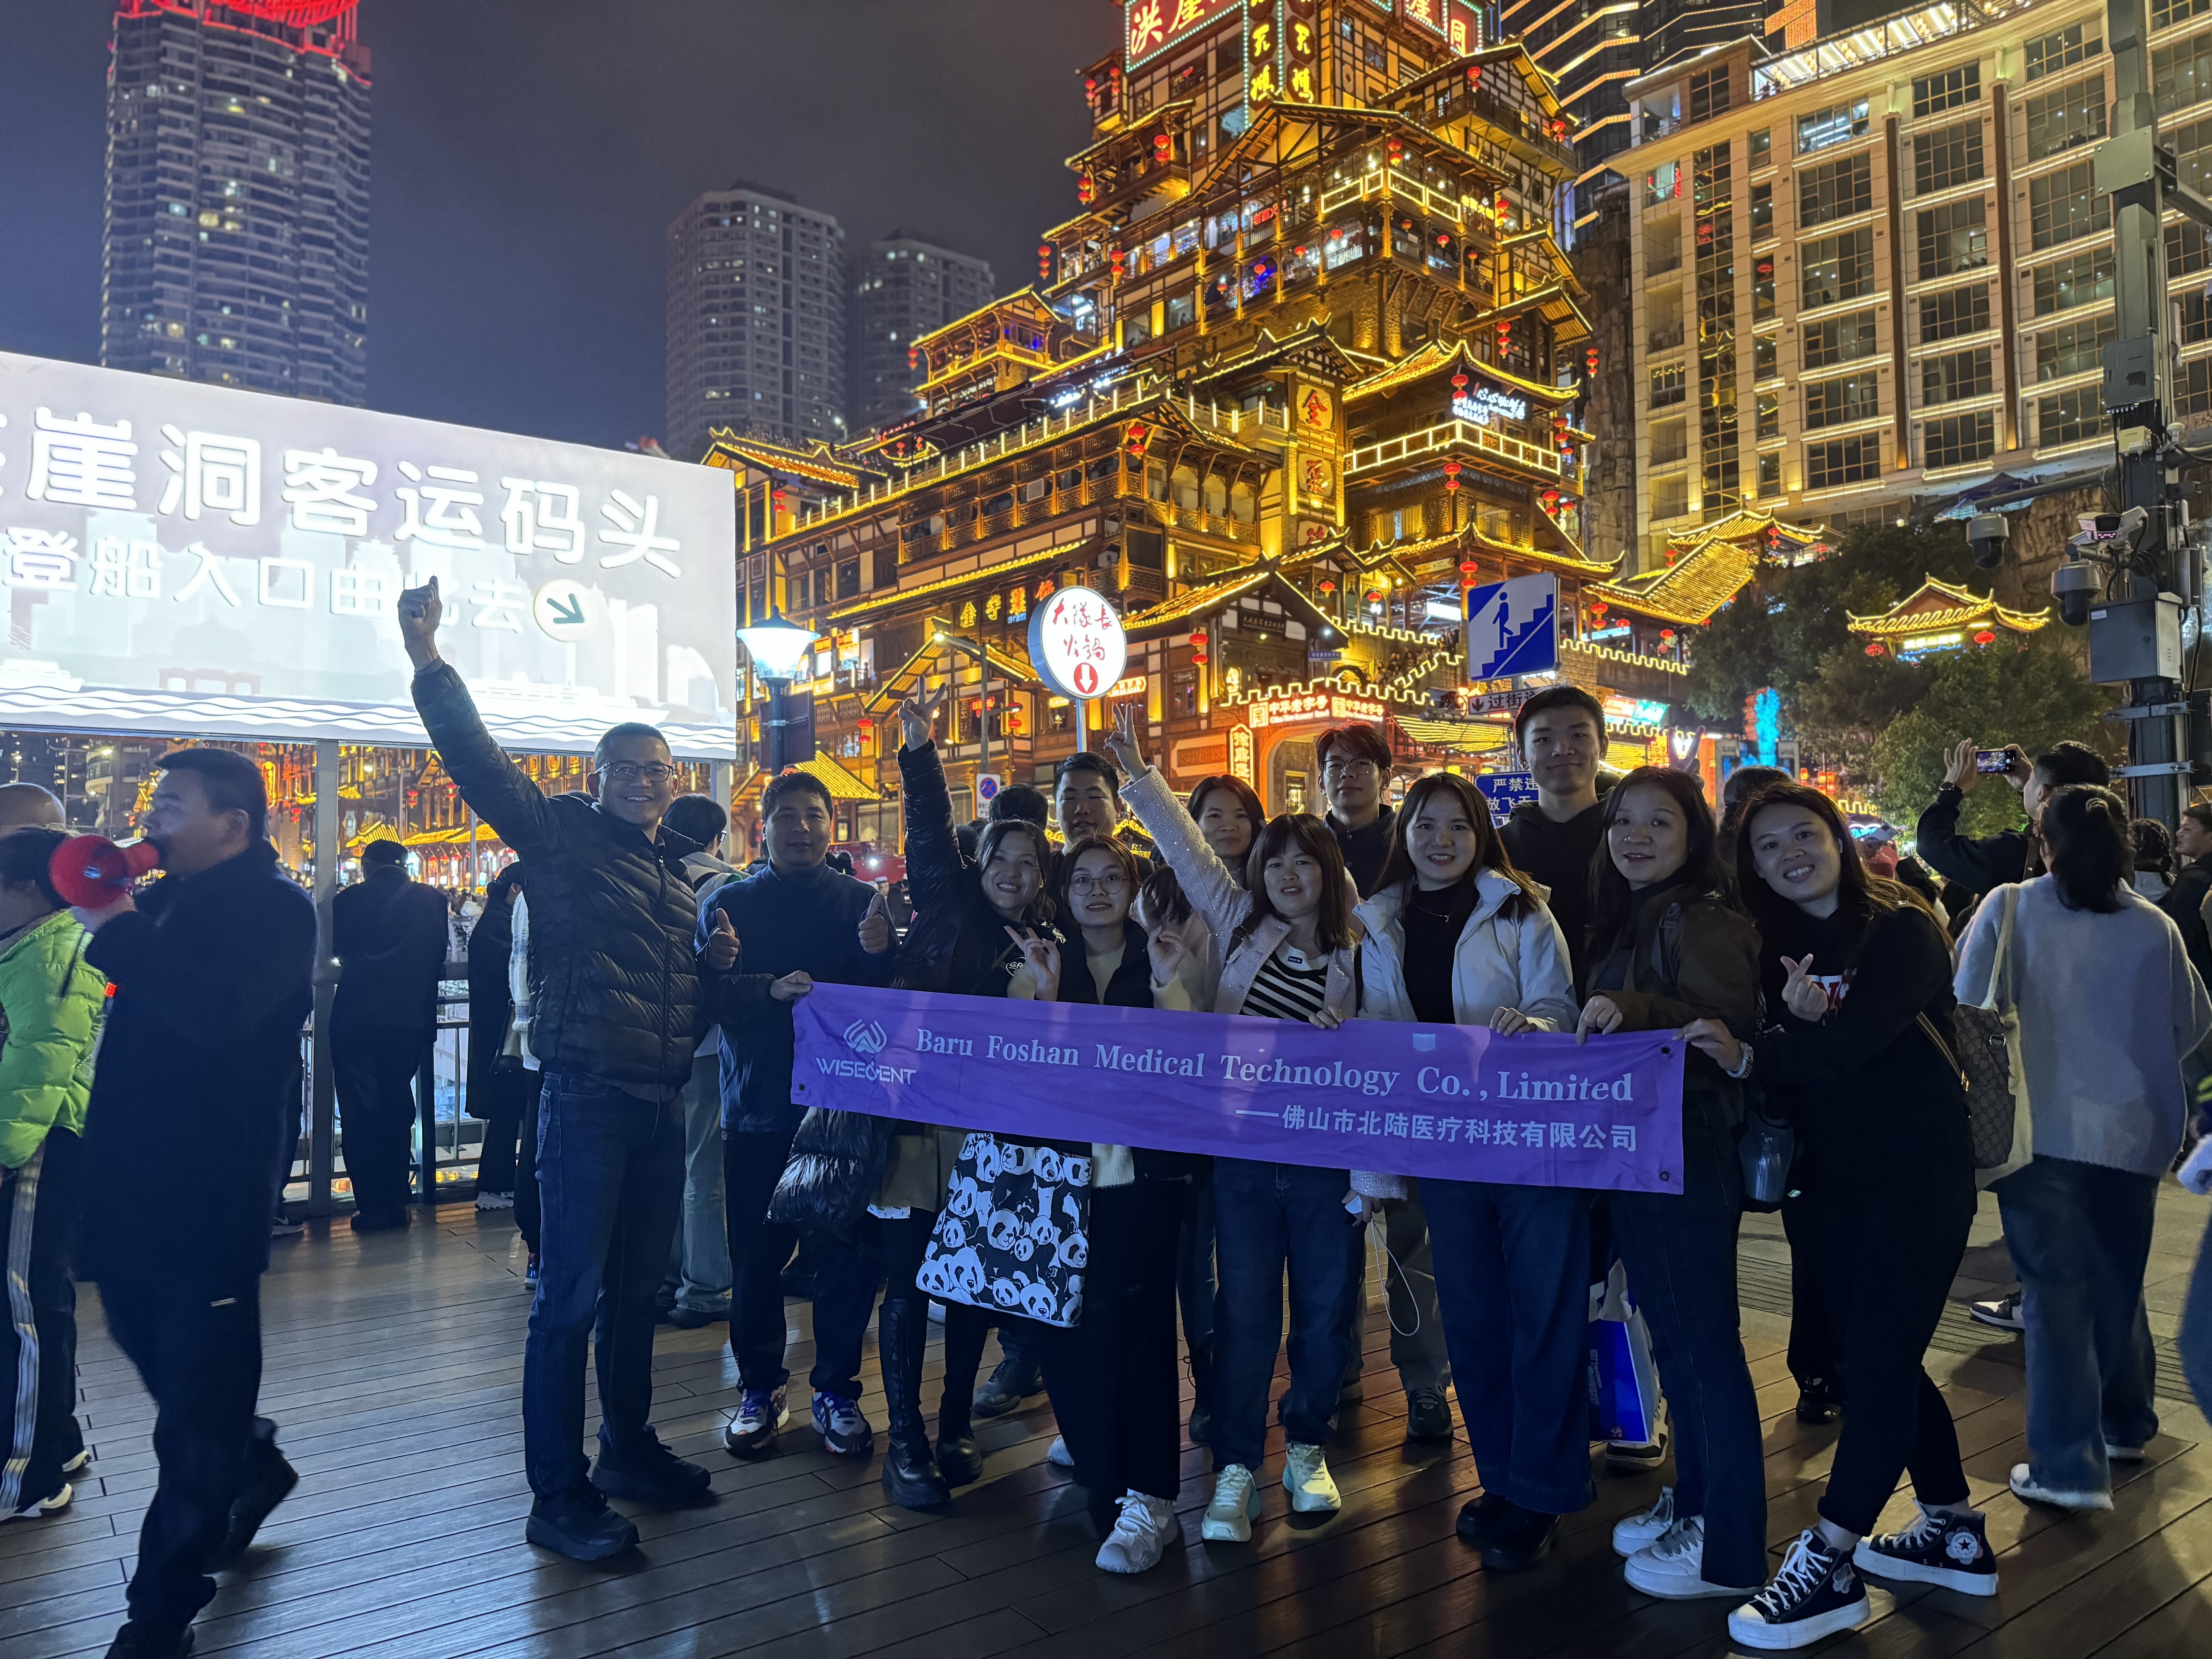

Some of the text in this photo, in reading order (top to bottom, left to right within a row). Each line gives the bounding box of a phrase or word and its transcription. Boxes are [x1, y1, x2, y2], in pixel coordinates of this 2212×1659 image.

[1131, 0, 1218, 55] 洪崖
[0, 407, 682, 579] 崖洞客运码头
[3, 527, 526, 634] 登船入口由去
[915, 1029, 973, 1056] Baru
[986, 1035, 1079, 1066] Foshan
[1093, 1044, 1204, 1077] Medical
[1220, 1054, 1400, 1096] Technology
